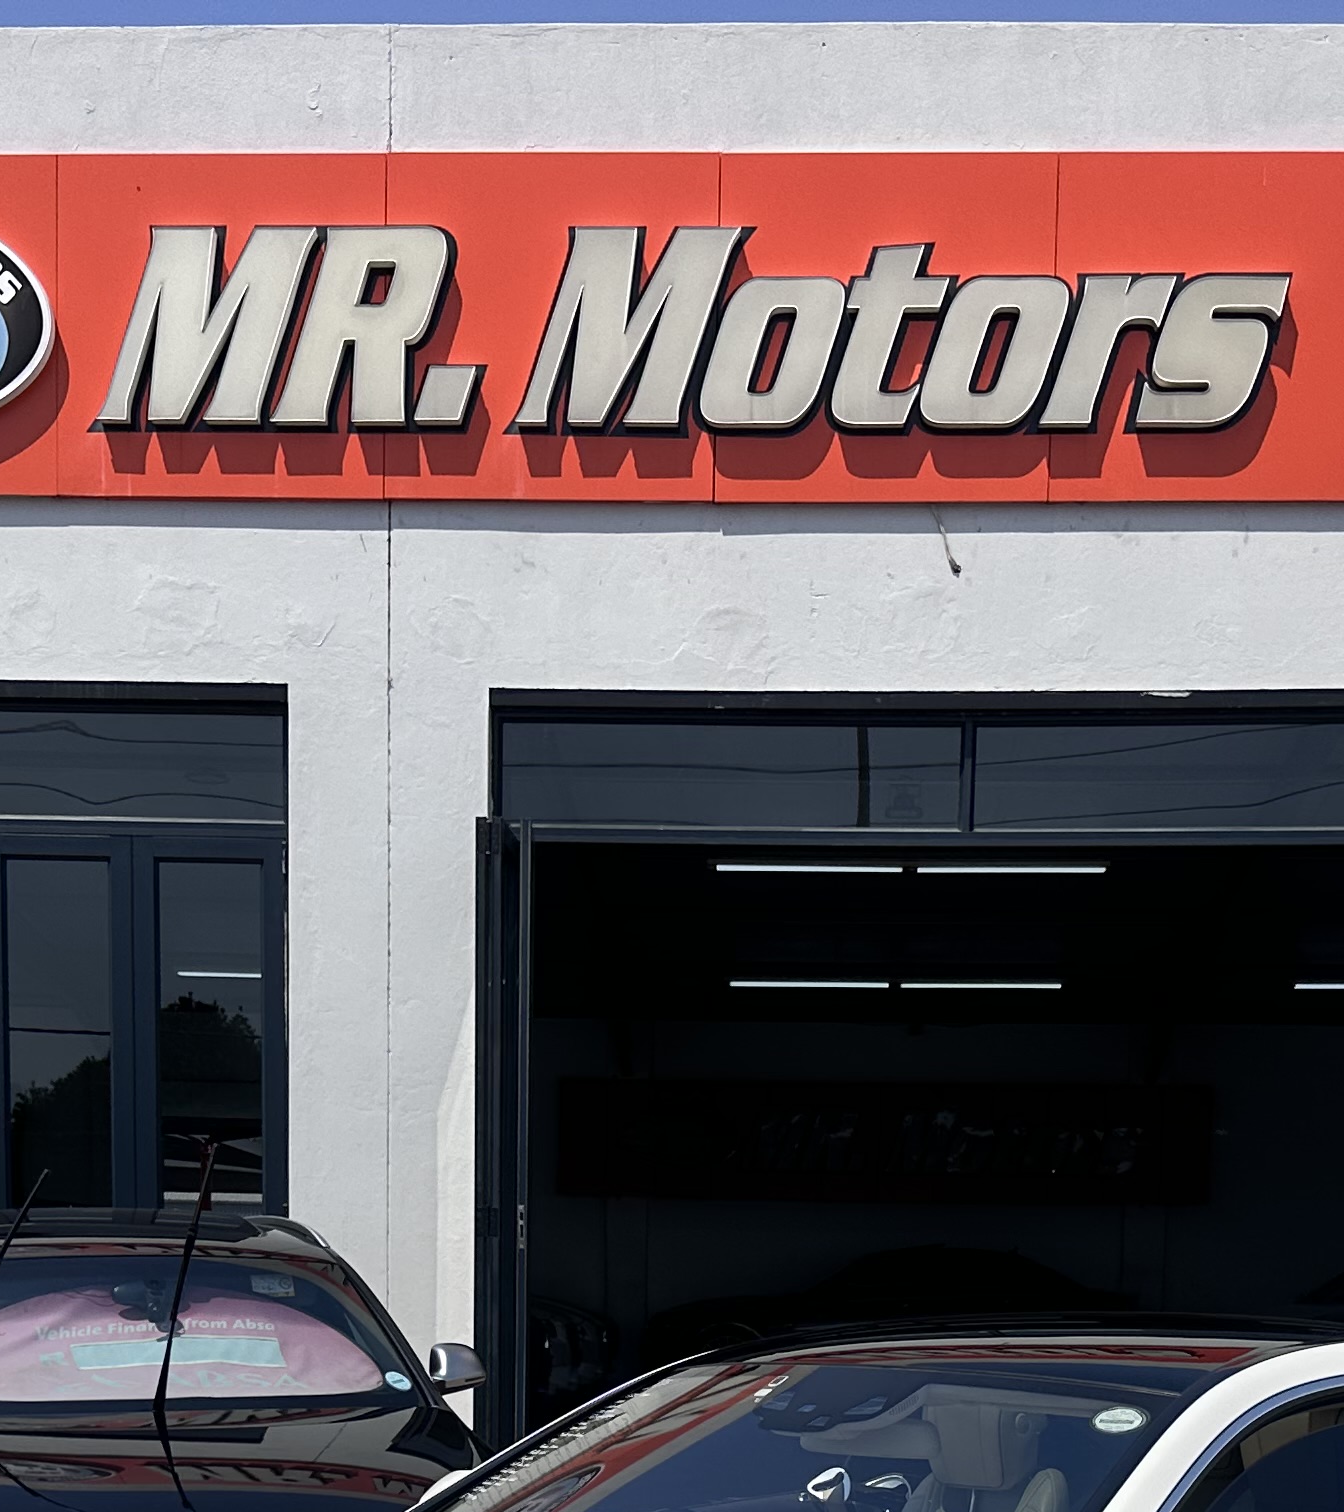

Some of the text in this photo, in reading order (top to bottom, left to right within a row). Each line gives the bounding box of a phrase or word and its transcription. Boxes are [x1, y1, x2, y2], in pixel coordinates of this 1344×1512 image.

[96, 225, 1292, 433] MR. Motors
[35, 1318, 276, 1341] Vehicle Finan from Absa
